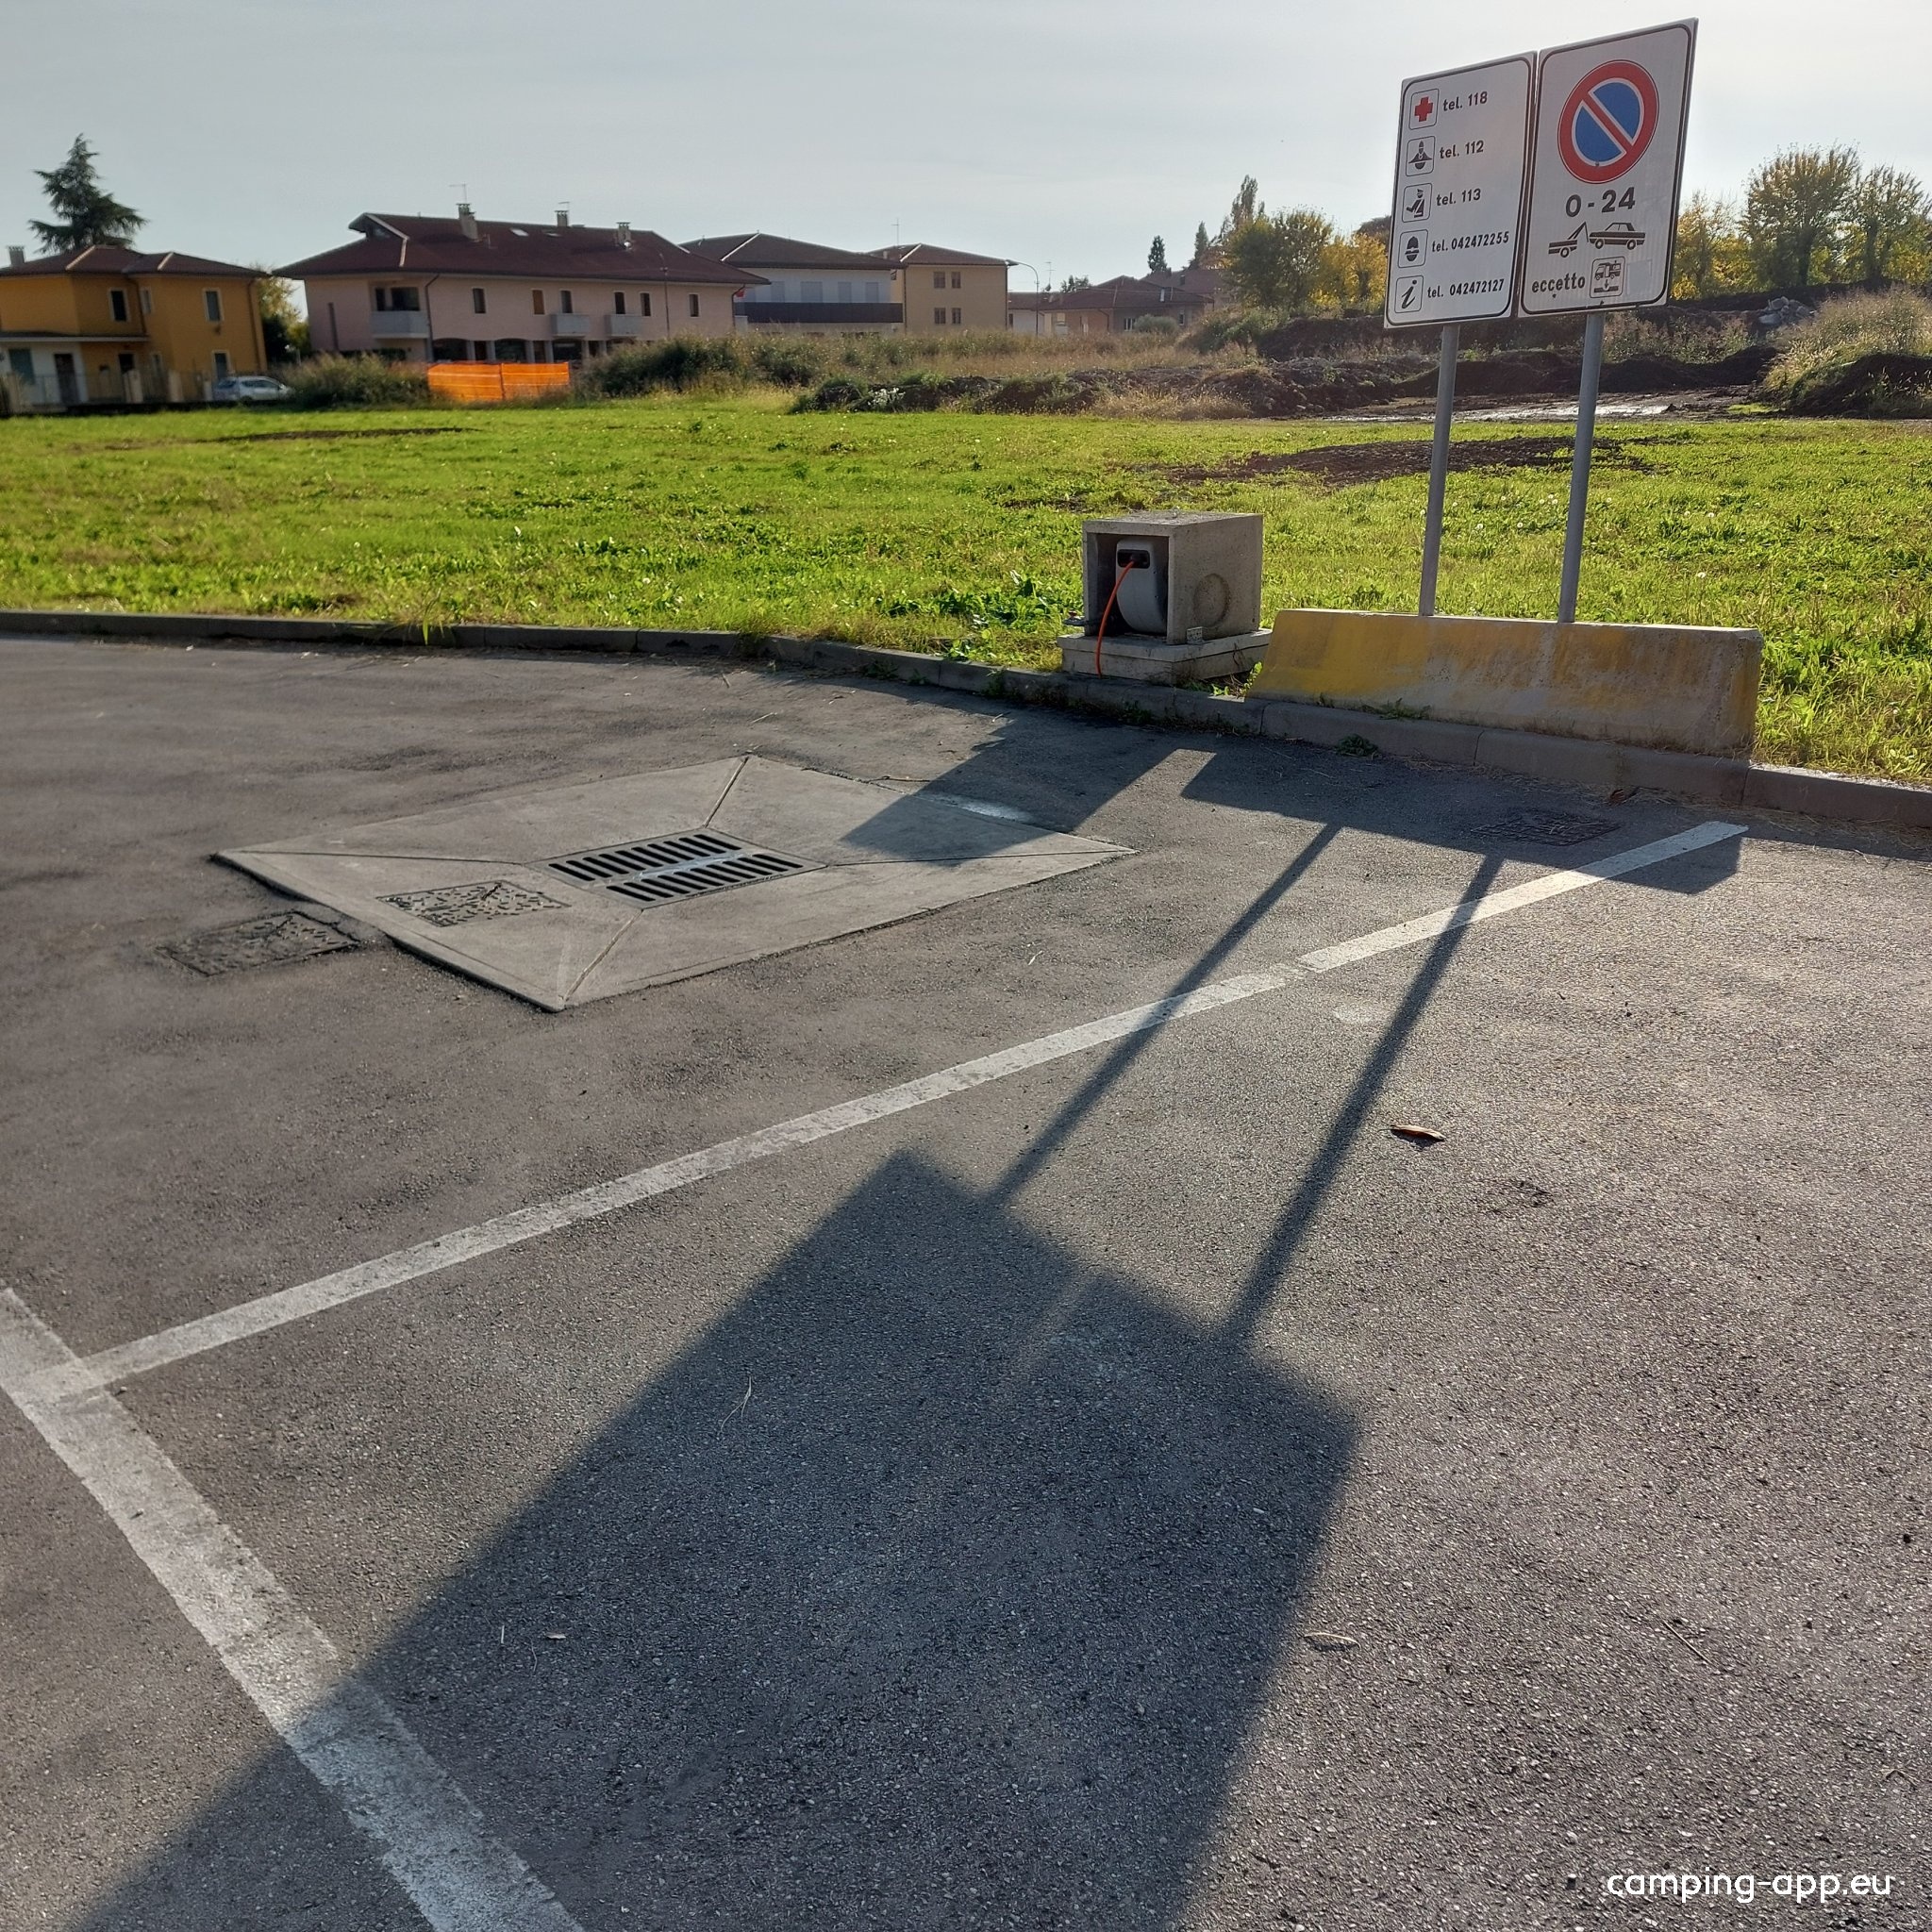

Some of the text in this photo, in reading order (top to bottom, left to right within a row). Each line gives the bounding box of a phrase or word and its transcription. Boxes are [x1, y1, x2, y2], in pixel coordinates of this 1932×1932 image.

[1442, 91, 1488, 111] tel. 118
[1439, 141, 1484, 159] tel. 112
[1436, 188, 1481, 207] tel. 113
[1431, 231, 1509, 253] tel. 042472255
[1427, 278, 1505, 299] tel. 042472127
[1531, 273, 1586, 293] eccetto
